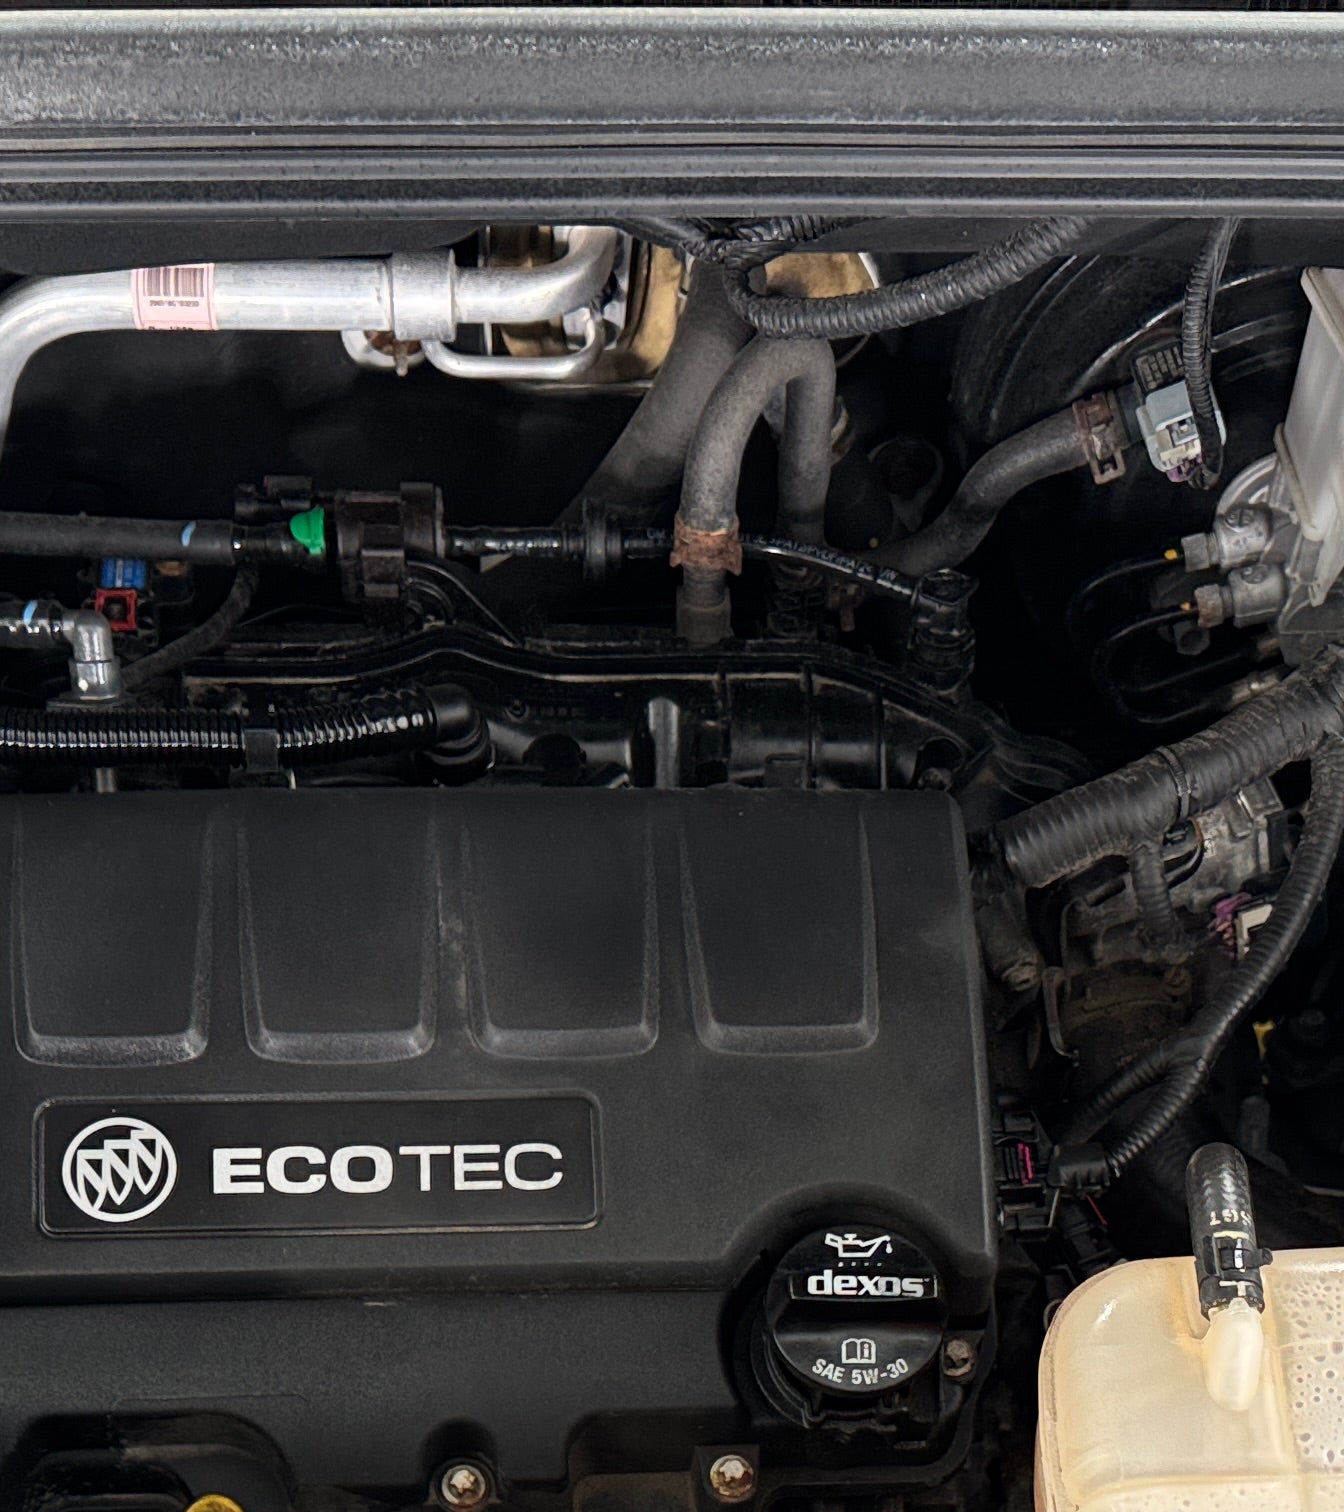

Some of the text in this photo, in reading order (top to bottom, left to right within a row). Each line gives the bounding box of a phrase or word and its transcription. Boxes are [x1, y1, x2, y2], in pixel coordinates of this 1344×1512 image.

[212, 1142, 564, 1195] ECOTEC
[807, 1268, 926, 1298] dexos
[812, 1358, 909, 1385] SAE 5W-30
